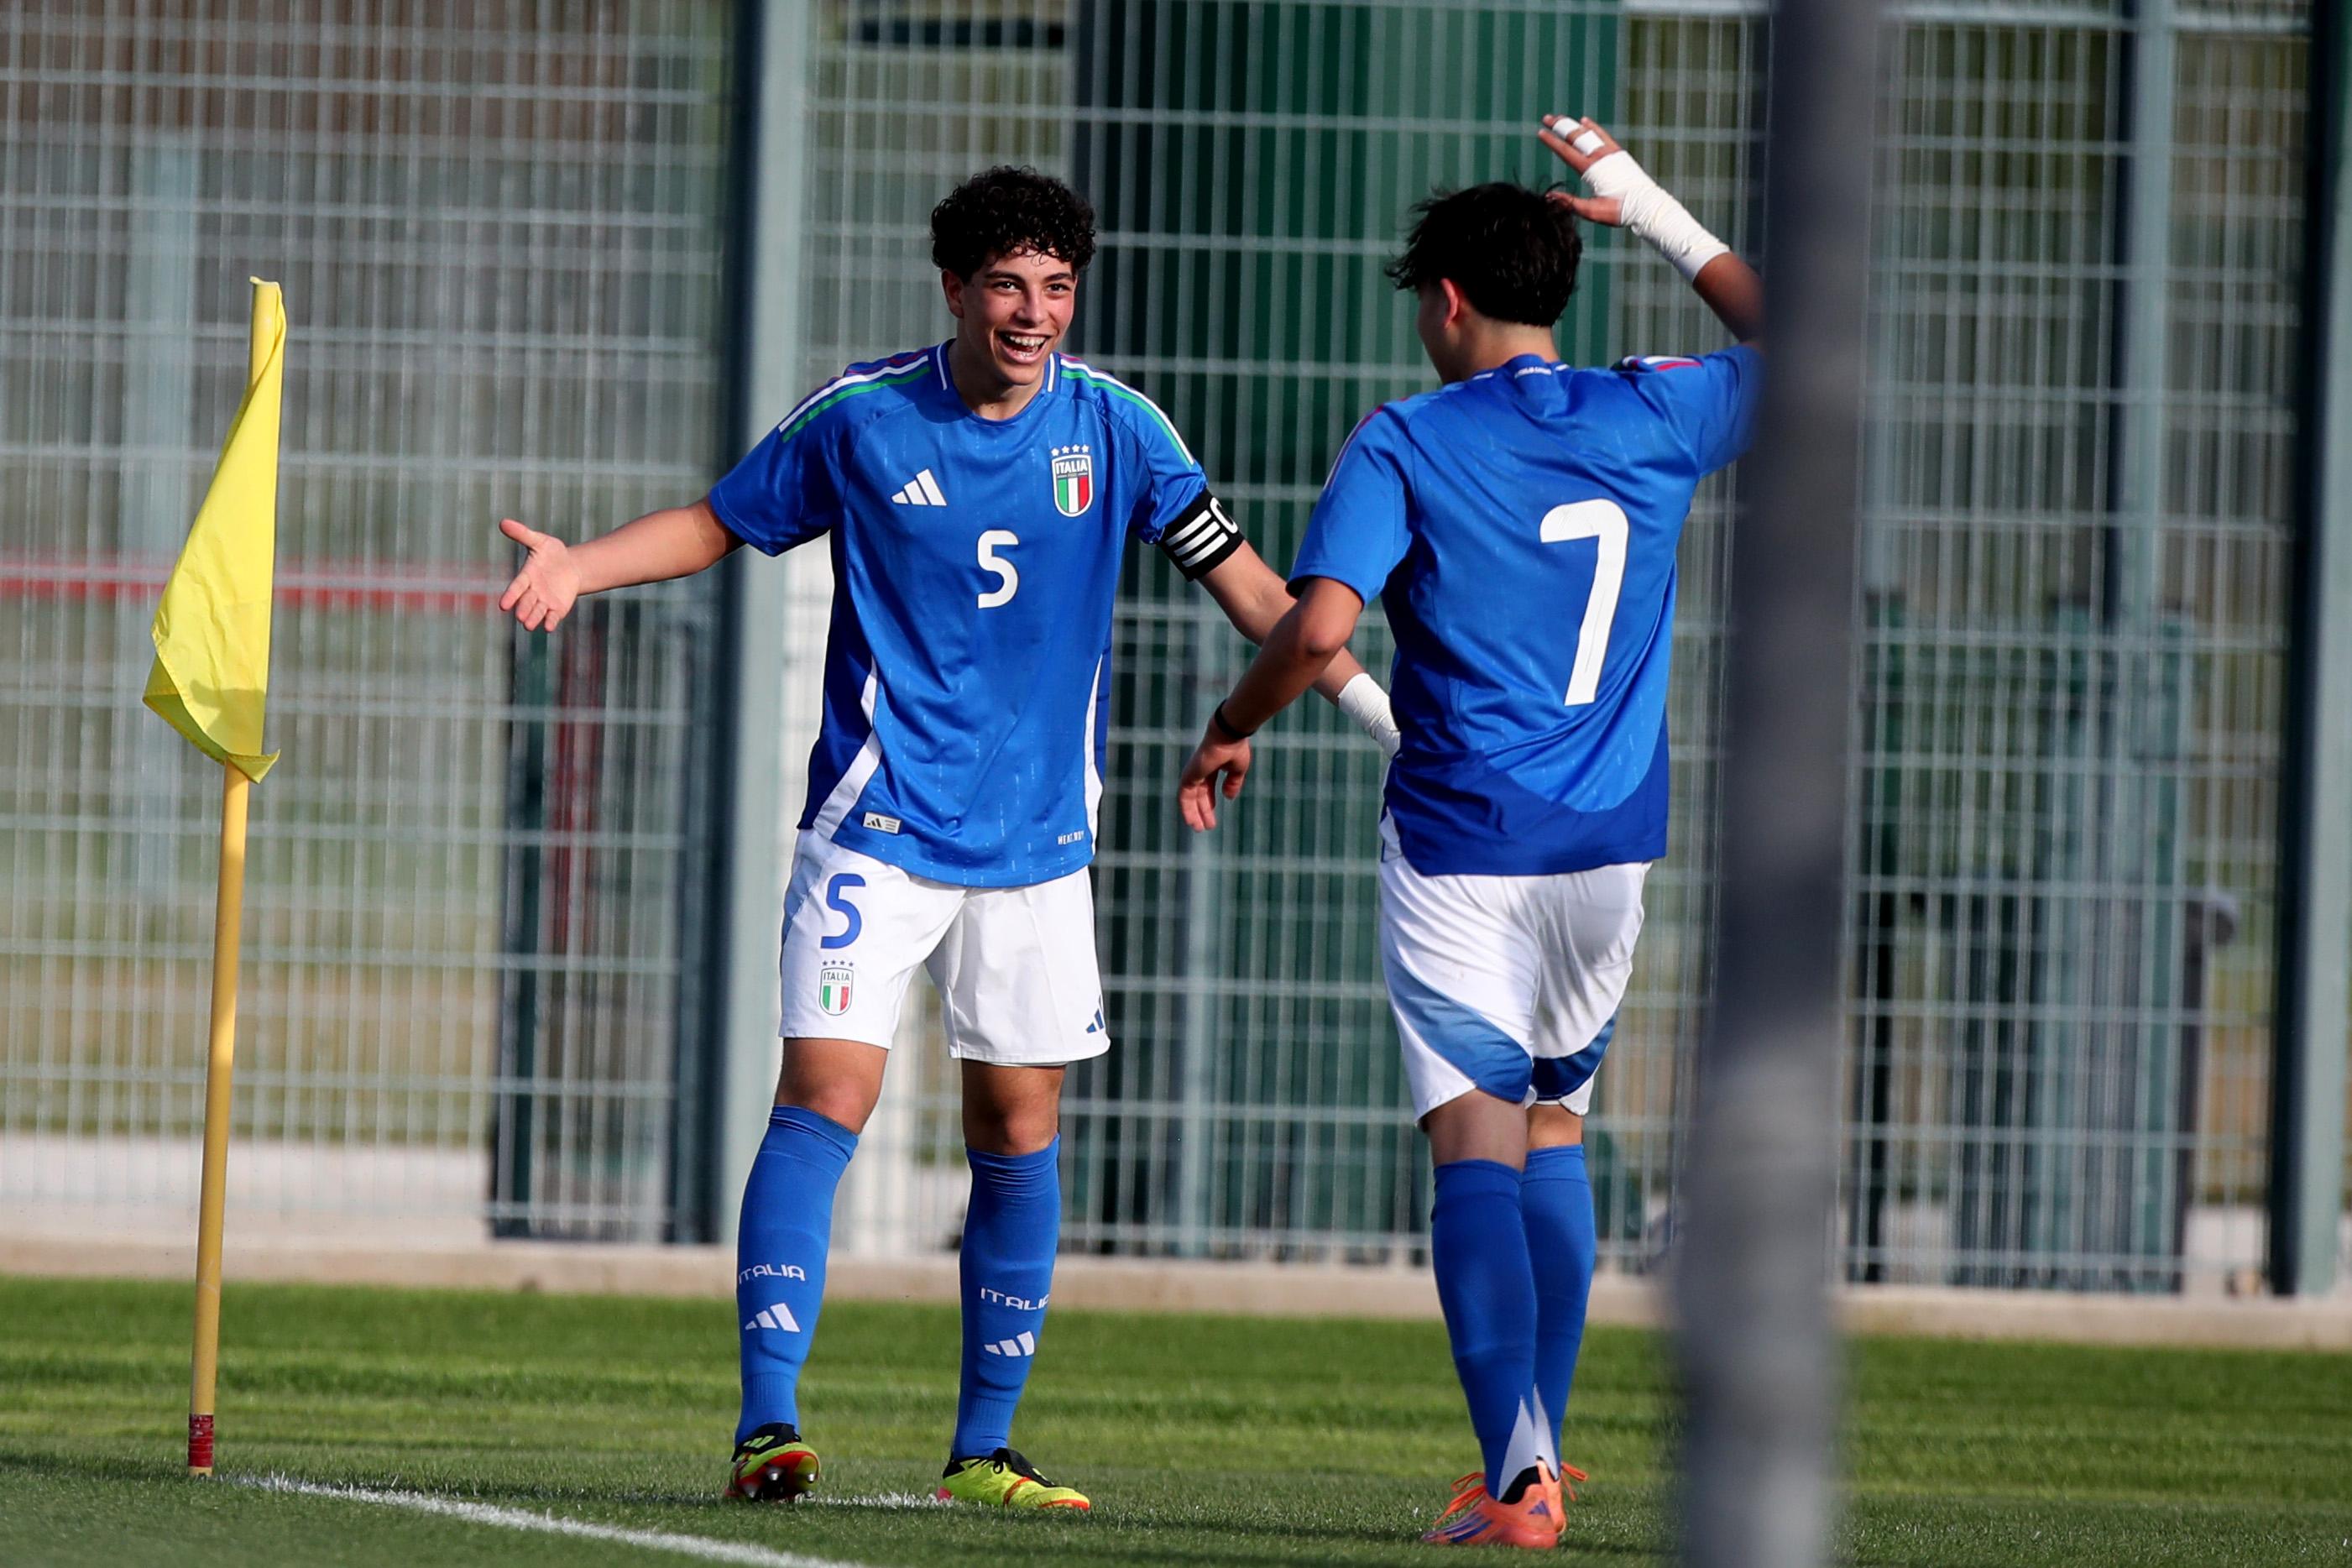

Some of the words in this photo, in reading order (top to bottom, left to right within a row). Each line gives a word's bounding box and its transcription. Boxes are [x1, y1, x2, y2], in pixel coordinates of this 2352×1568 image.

[1056, 459, 1088, 474] ITALIA
[977, 530, 1019, 609] 5
[1539, 498, 1629, 706] 7
[820, 873, 866, 949] 5
[823, 972, 849, 980] ITALIA
[739, 1263, 806, 1284] ITALIA
